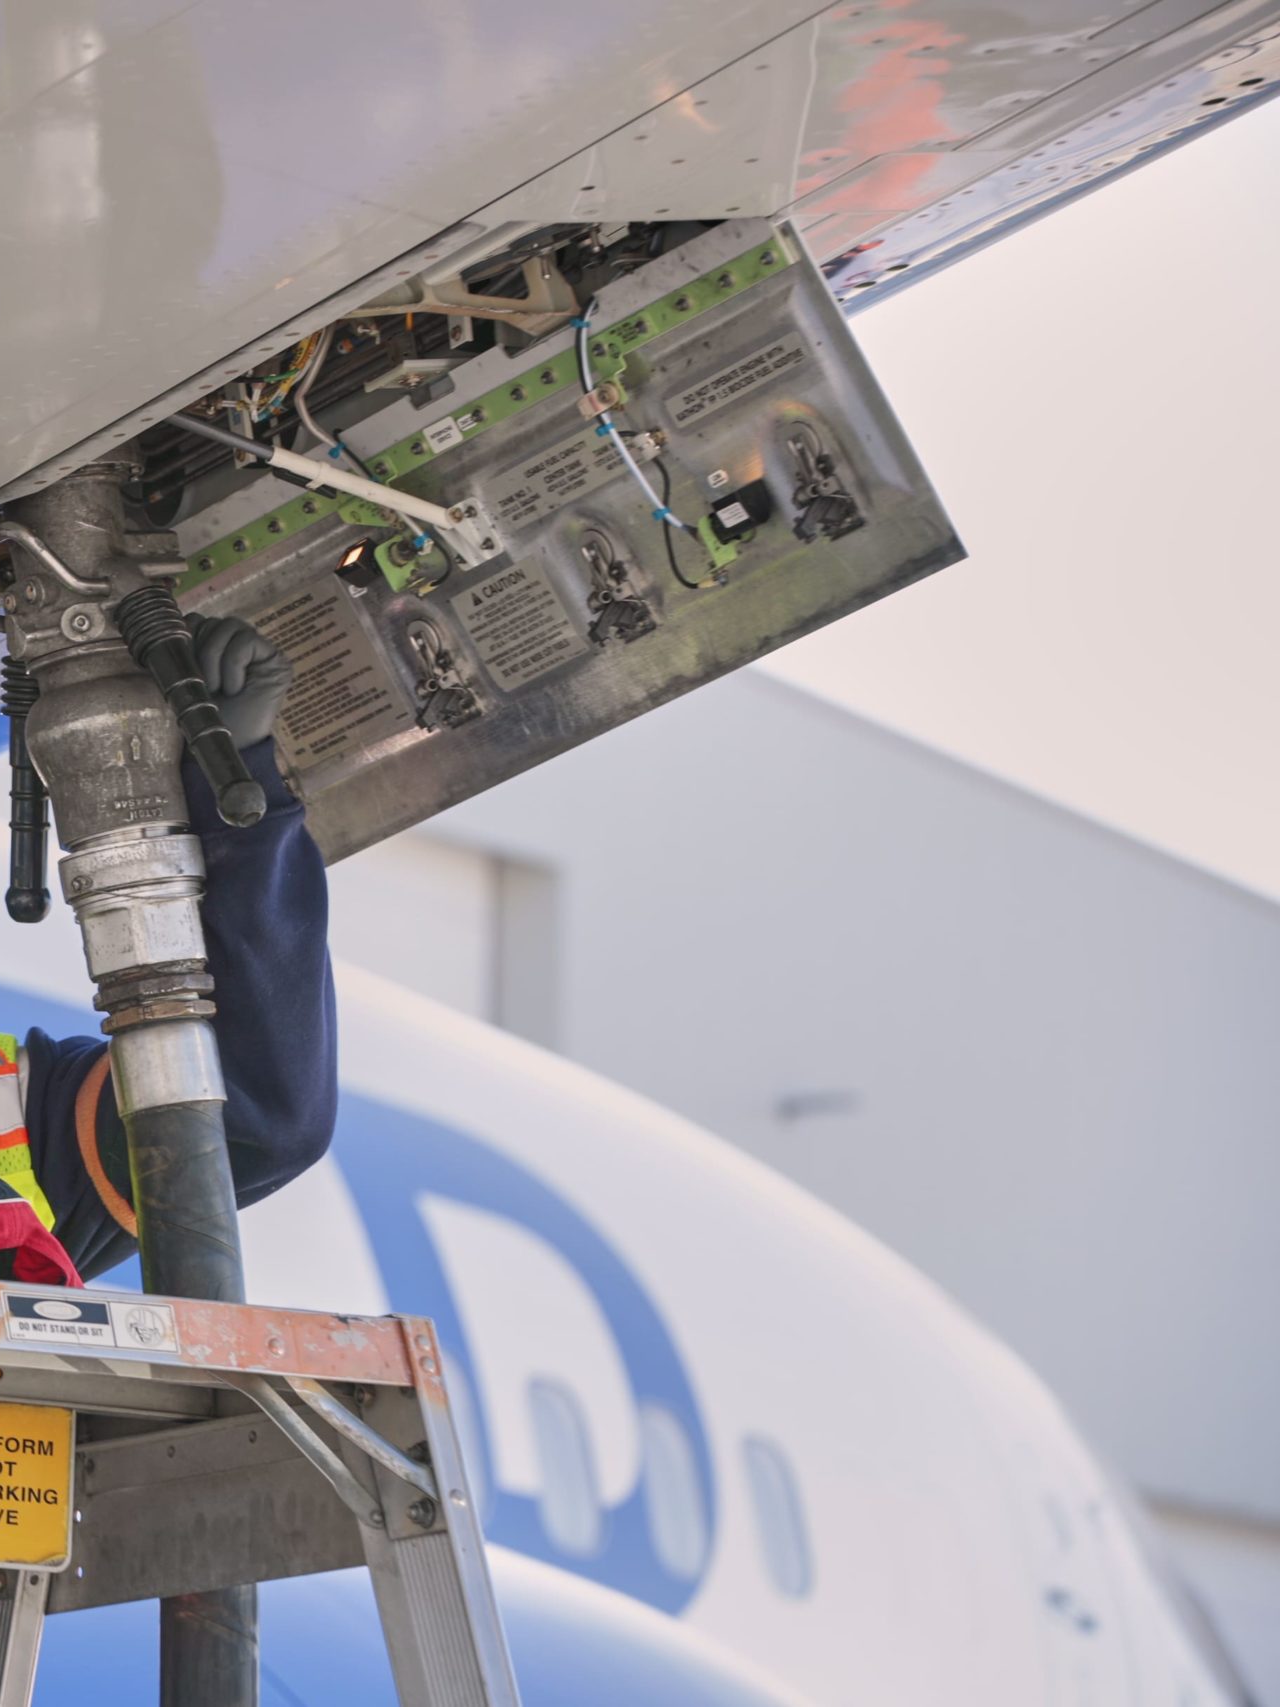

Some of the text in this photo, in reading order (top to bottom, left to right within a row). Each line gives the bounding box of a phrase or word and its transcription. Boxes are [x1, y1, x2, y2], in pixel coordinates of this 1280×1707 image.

[481, 568, 526, 599] CAUTION
[19, 1321, 103, 1337] DO NOT STAND OR SIT
